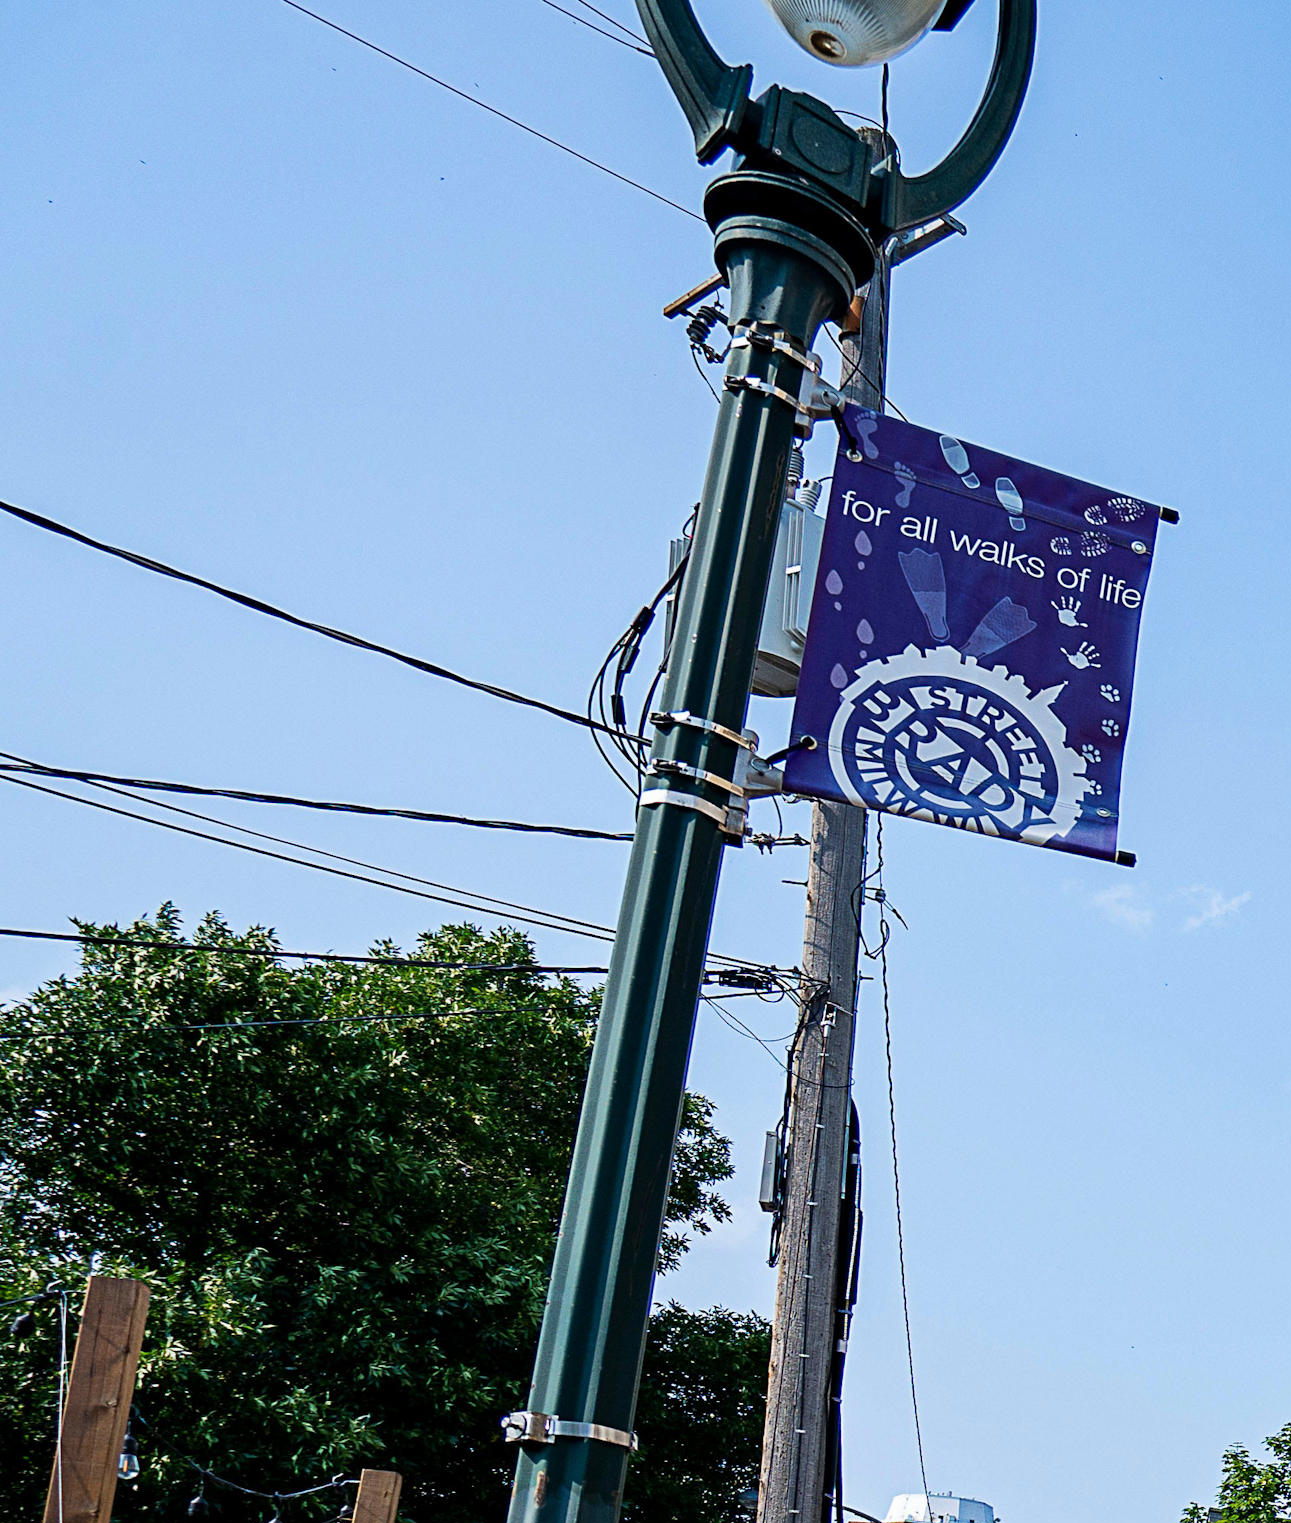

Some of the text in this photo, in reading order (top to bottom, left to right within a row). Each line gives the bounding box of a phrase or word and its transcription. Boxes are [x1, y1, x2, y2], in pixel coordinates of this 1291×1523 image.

[841, 490, 1142, 609] for all walks of life
[851, 679, 1058, 839] BRADY
[927, 684, 1048, 801] STREET
